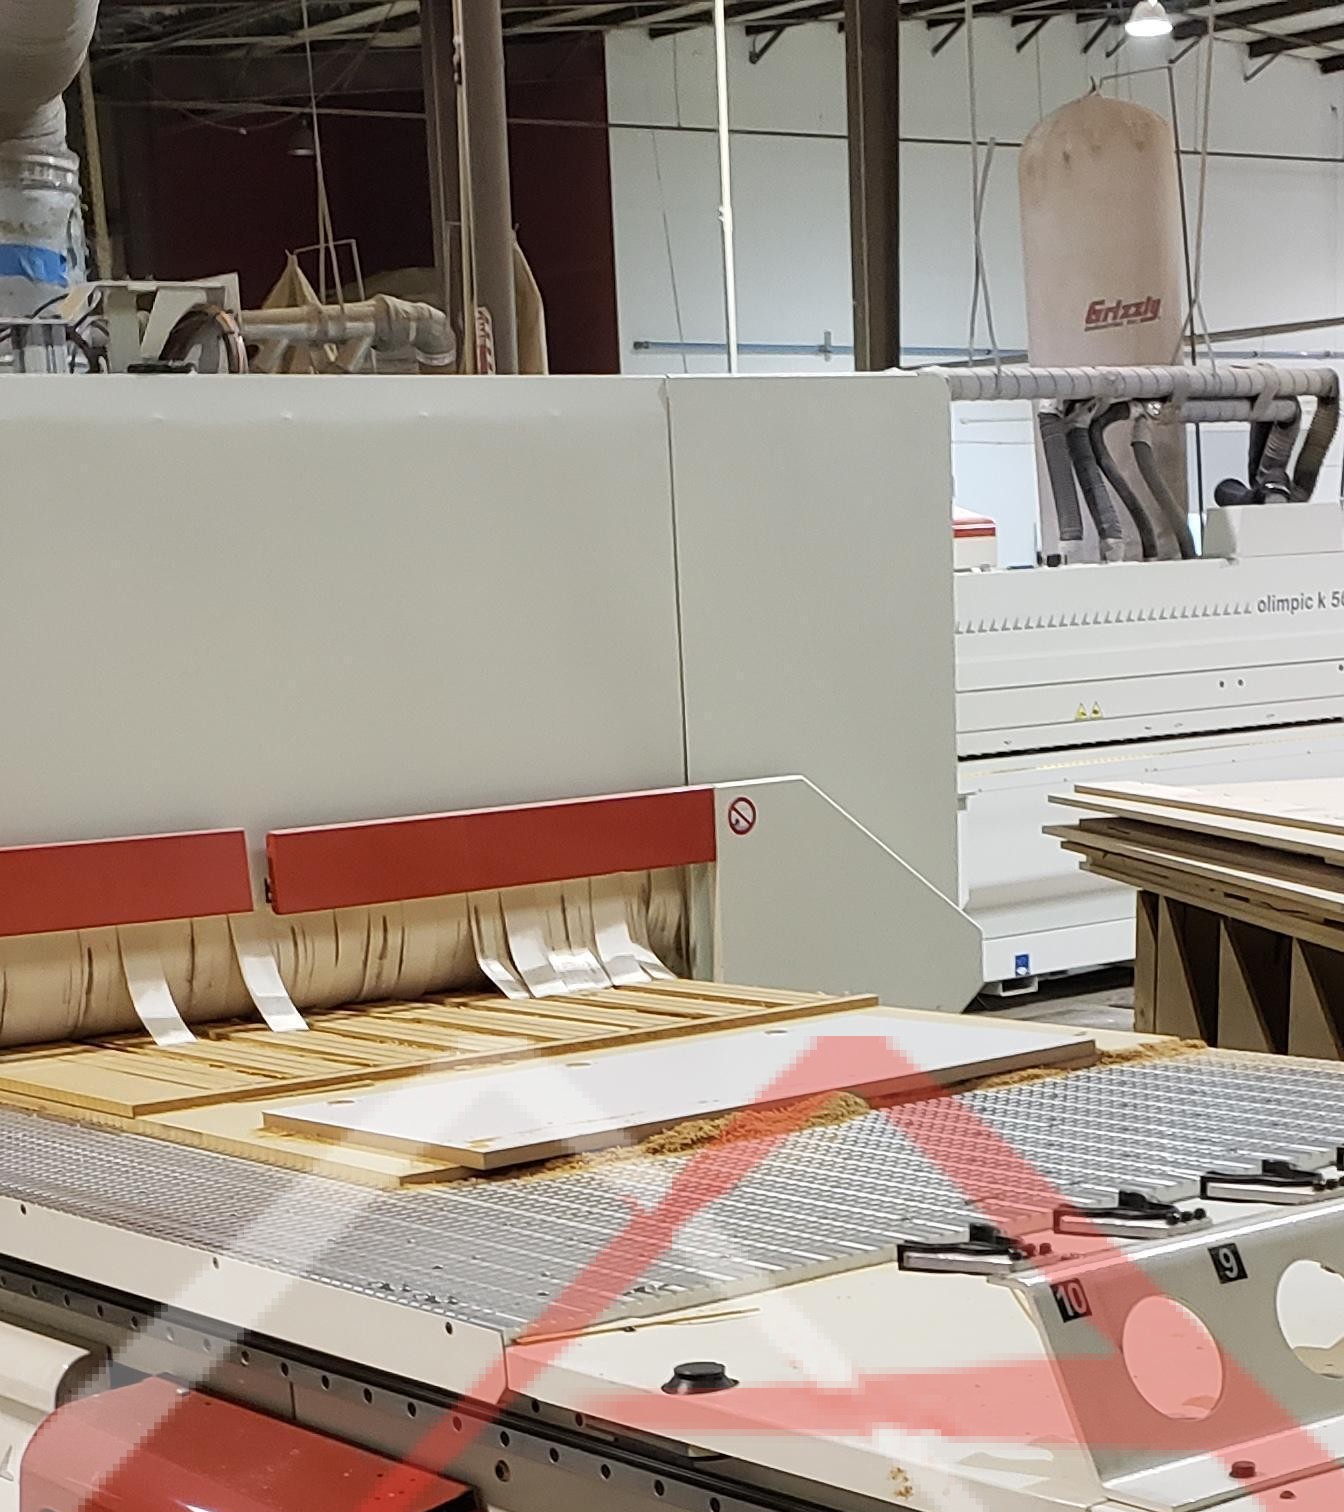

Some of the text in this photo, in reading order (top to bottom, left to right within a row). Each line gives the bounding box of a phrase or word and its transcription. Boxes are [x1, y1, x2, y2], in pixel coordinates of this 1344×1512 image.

[1084, 295, 1162, 324] Grizzly
[1257, 593, 1314, 615] olimpic
[1317, 591, 1326, 609] k
[1056, 1281, 1087, 1317] 10
[1218, 1247, 1239, 1279] 9
